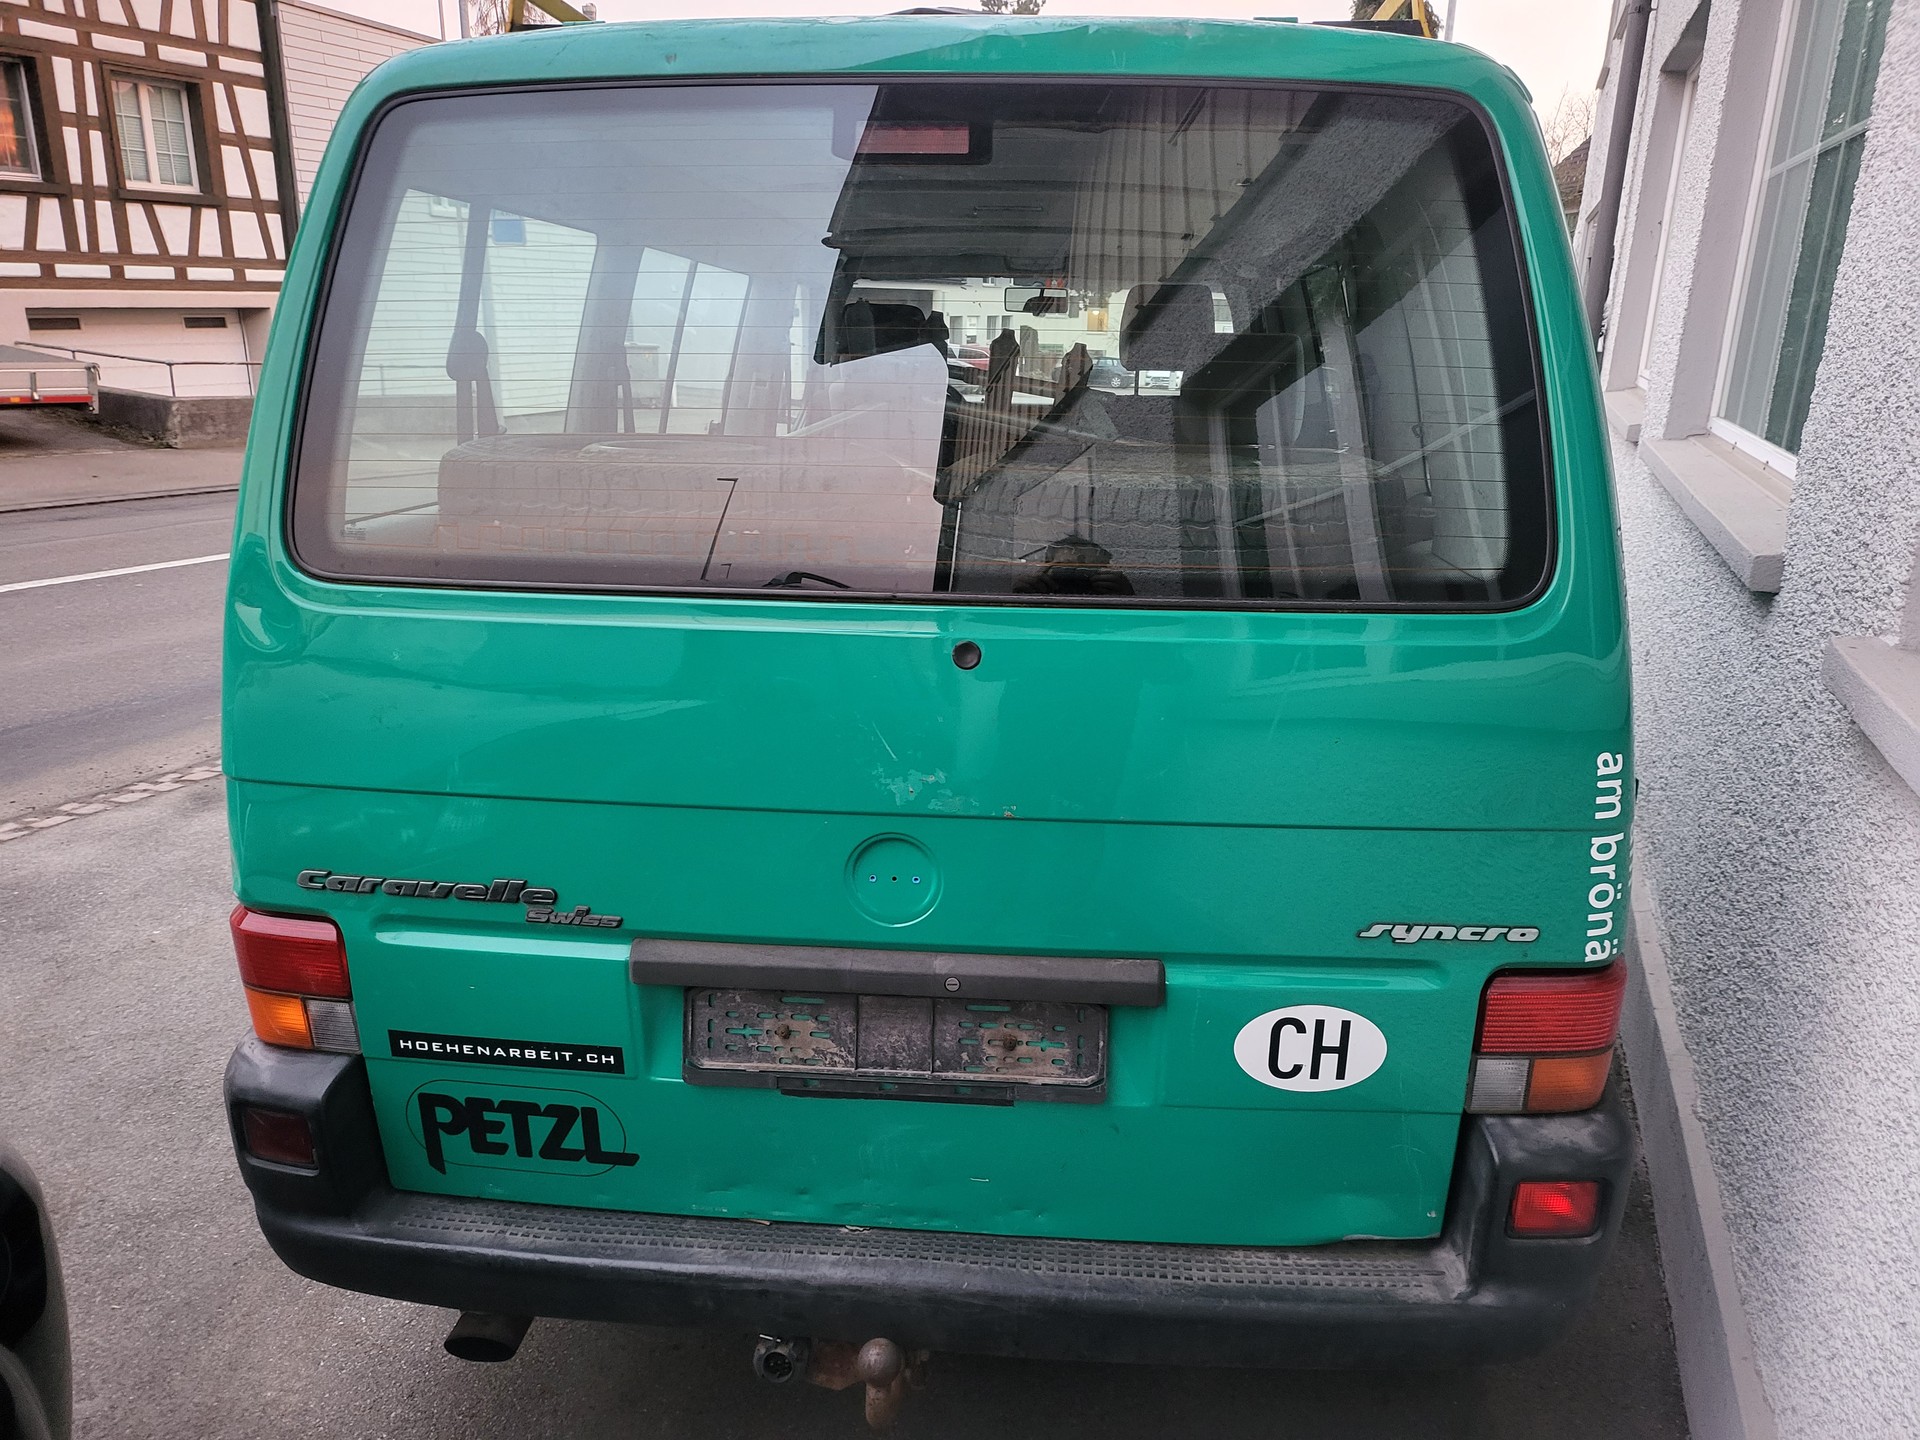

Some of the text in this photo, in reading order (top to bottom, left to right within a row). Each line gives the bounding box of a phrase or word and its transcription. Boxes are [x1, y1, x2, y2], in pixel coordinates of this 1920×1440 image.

[1584, 752, 1625, 963] am brönä
[297, 868, 558, 905] Caravelle
[524, 905, 624, 929] Swiss
[1357, 922, 1541, 945] syncro
[399, 1038, 616, 1065] HOEHENARBEIT.CH
[1267, 1016, 1352, 1081] CH
[416, 1092, 641, 1176] PETZL
